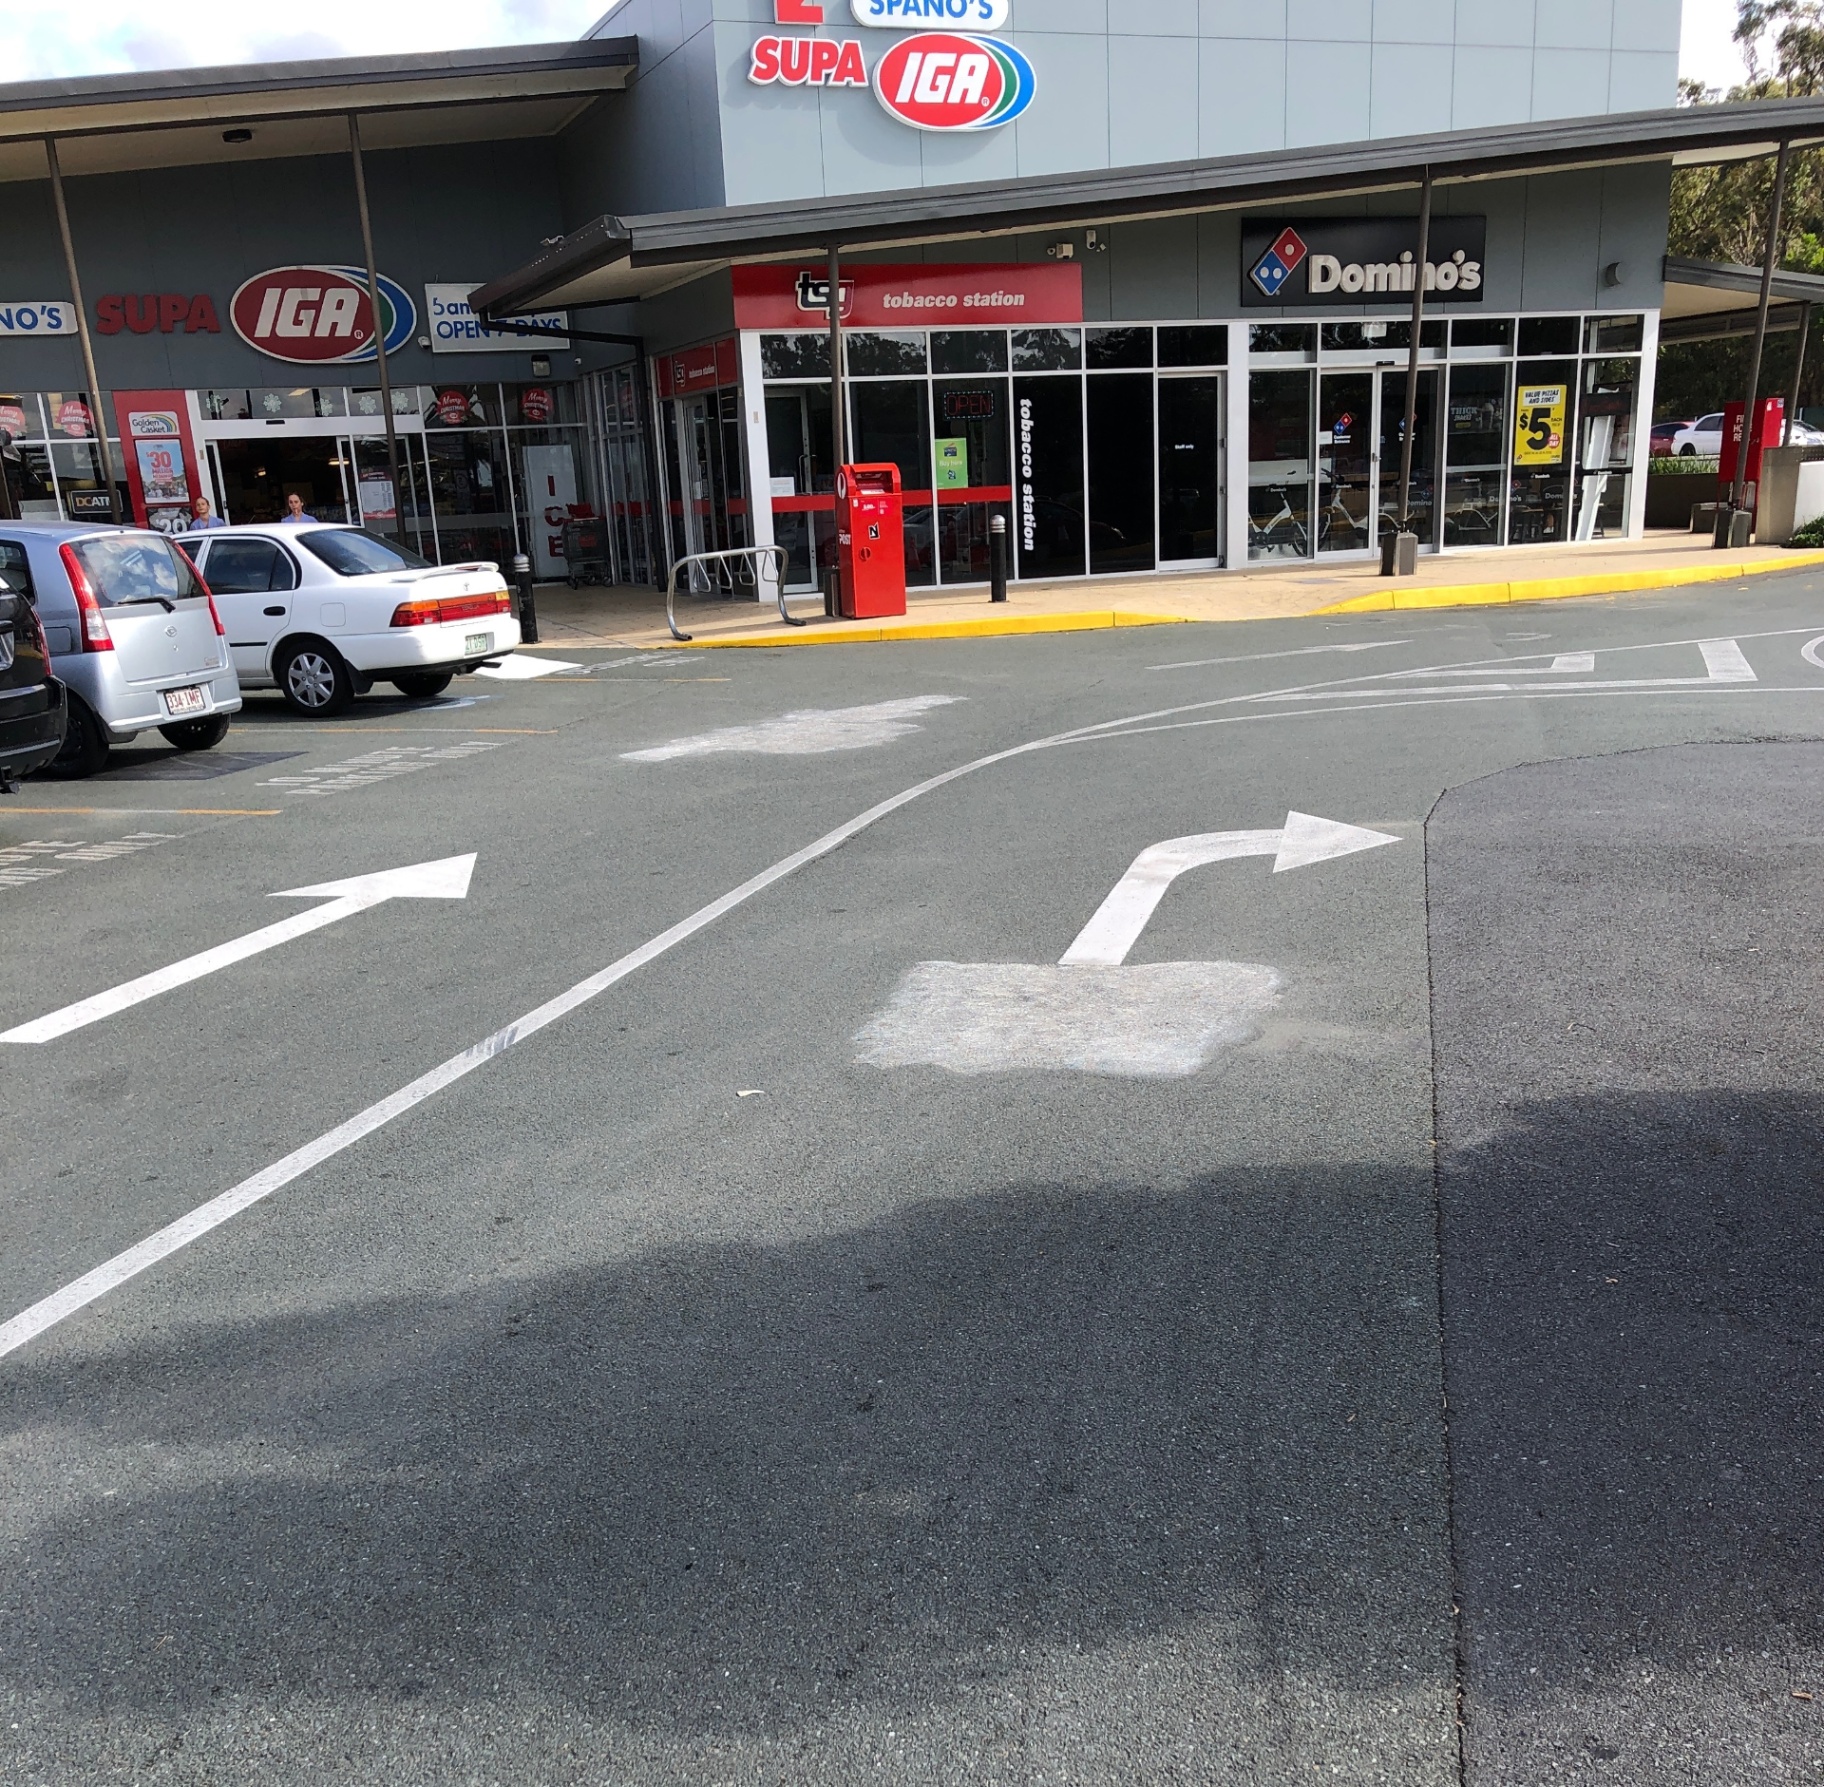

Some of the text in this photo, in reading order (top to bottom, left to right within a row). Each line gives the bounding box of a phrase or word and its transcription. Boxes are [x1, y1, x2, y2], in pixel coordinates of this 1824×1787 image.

[869, 0, 994, 19] SPANO'S
[750, 36, 868, 87] SUPA
[895, 52, 990, 104] IGA
[1309, 250, 1481, 293] Domino's
[96, 294, 221, 335] SUPA
[254, 288, 360, 338] IGA
[883, 290, 1025, 309] tobacco station
[436, 320, 491, 339] OPEN
[946, 394, 990, 415] OPEN
[132, 419, 160, 427] Golden
[140, 425, 166, 433] Casket
[1020, 399, 1037, 551] tobacco station
